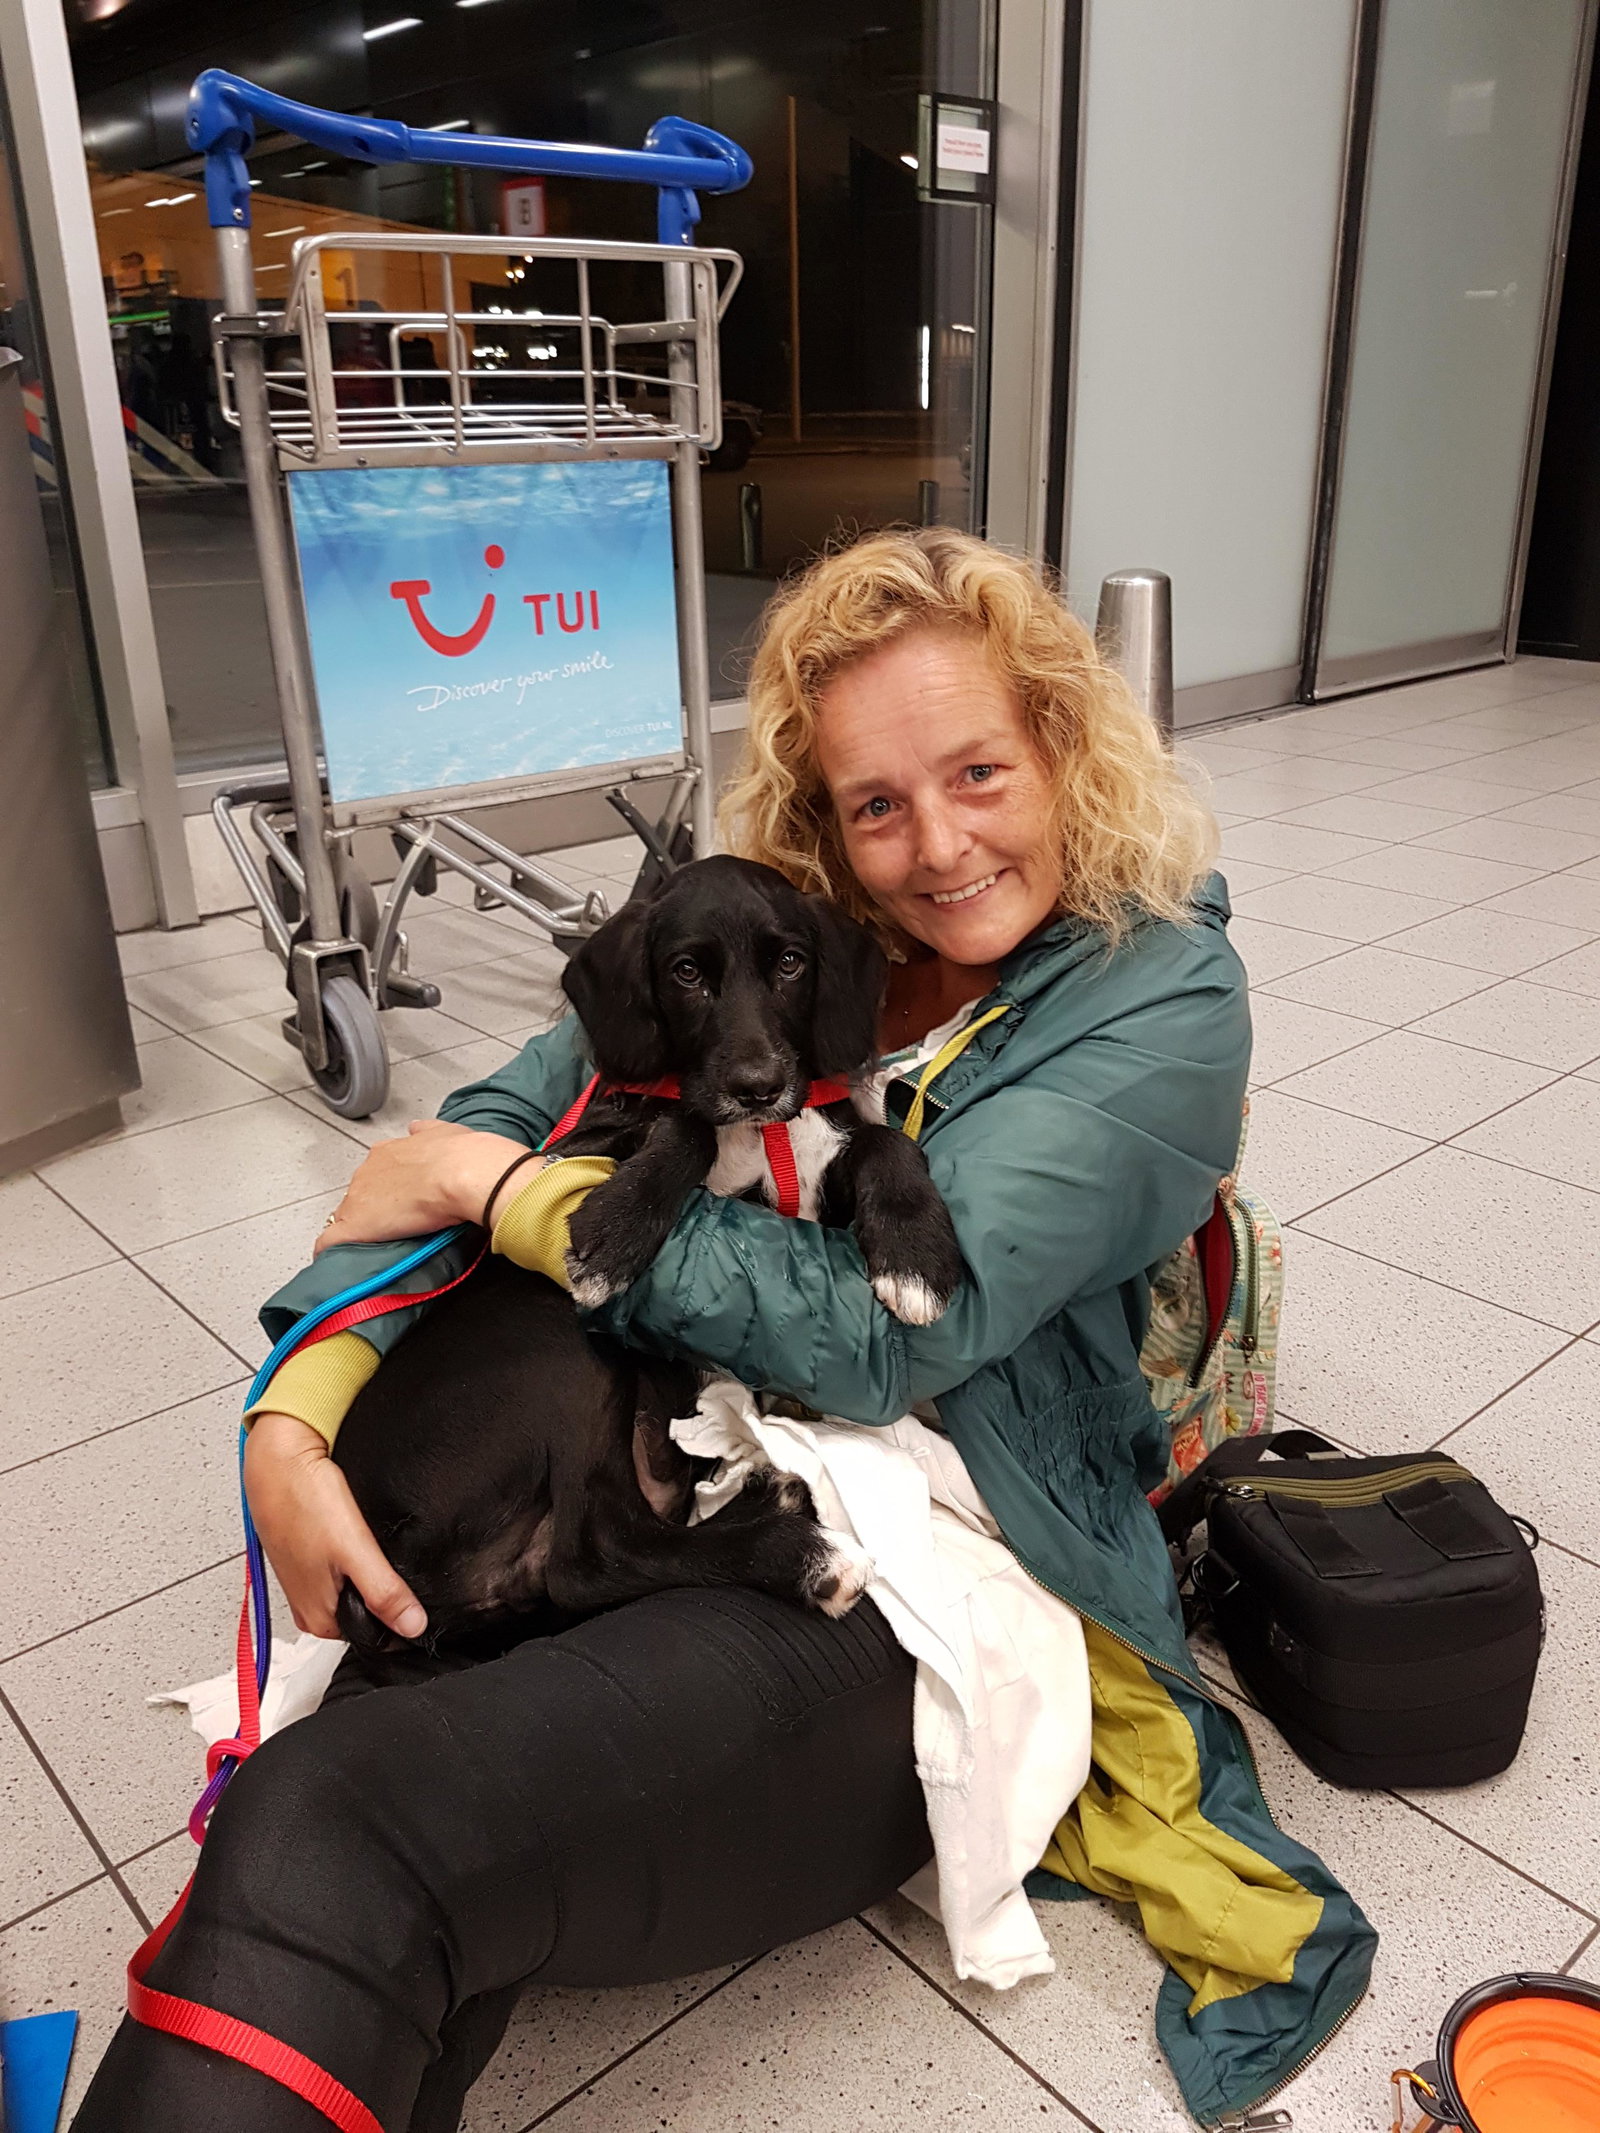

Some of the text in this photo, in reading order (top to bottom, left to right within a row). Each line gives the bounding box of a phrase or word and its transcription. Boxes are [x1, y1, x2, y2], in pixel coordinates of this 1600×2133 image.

[523, 590, 599, 635] TUI
[407, 651, 615, 711] Discover your smile
